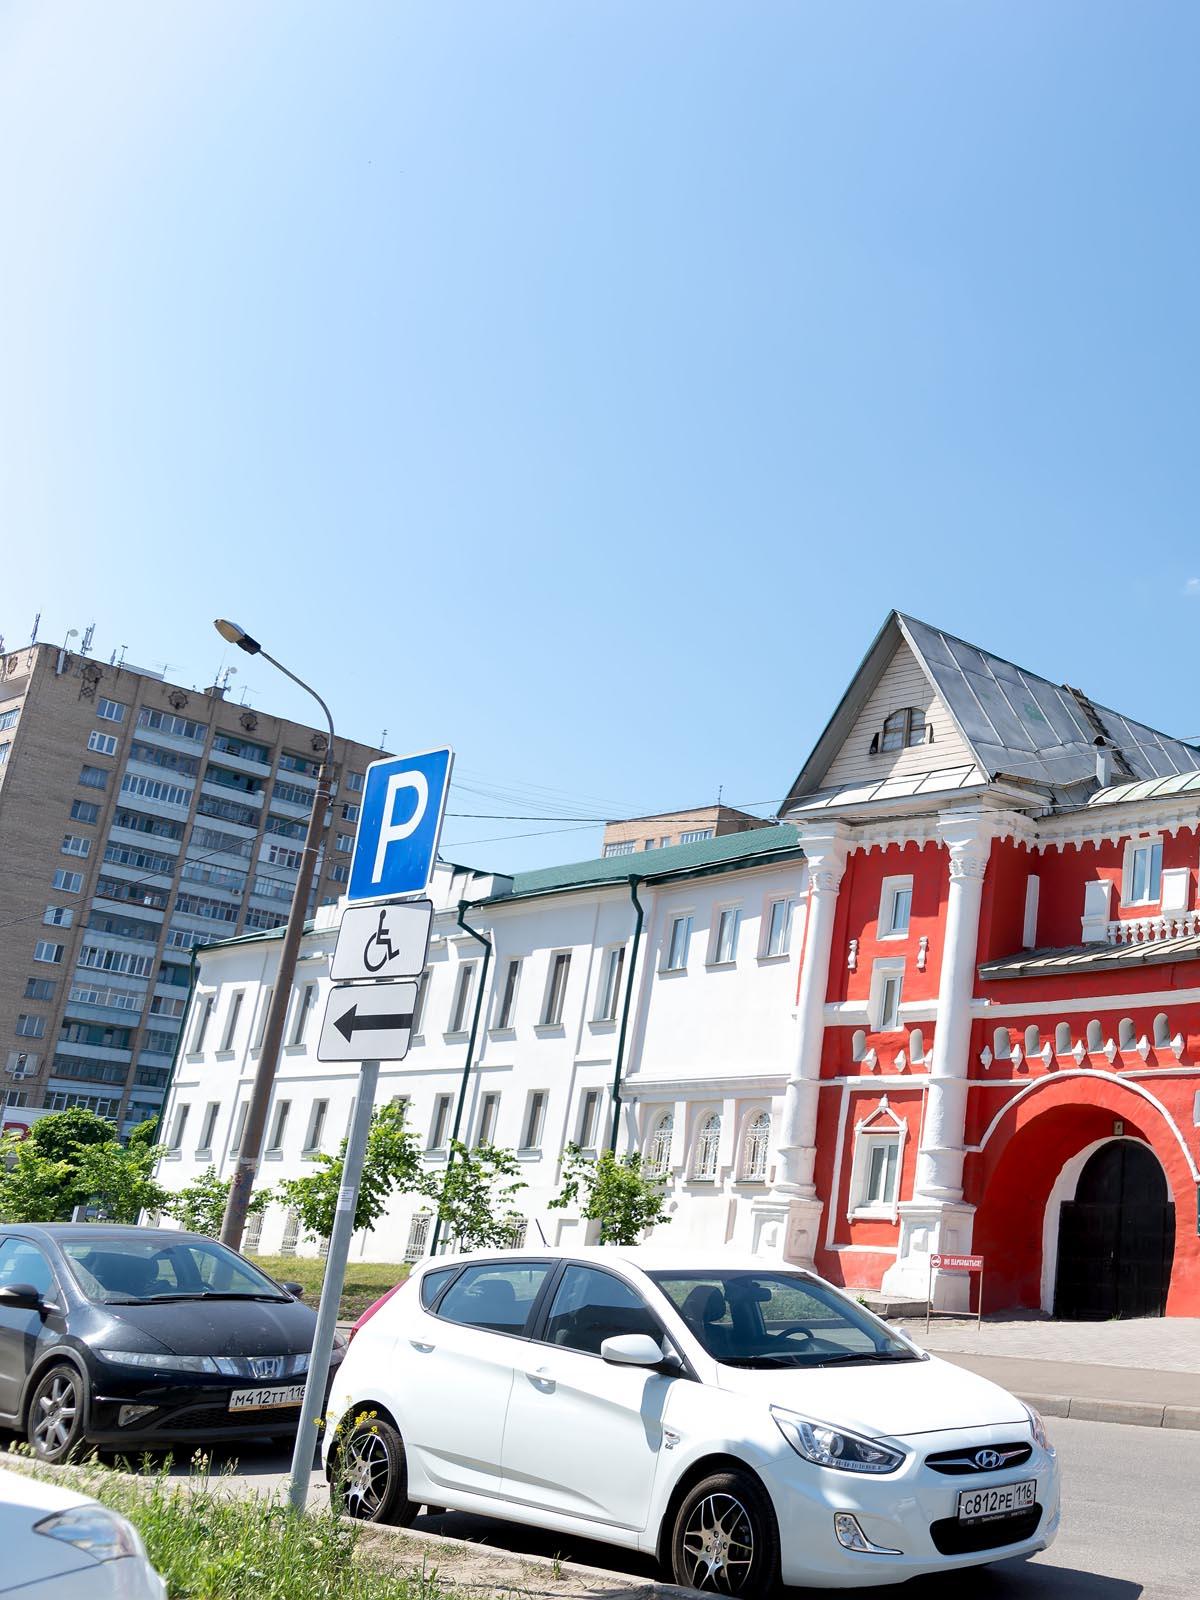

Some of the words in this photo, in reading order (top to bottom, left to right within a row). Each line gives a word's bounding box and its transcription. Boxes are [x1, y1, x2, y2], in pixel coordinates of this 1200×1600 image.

[371, 770, 428, 884] P
[965, 1491, 1013, 1515] С812РЕ
[1016, 1483, 1032, 1500] 116
